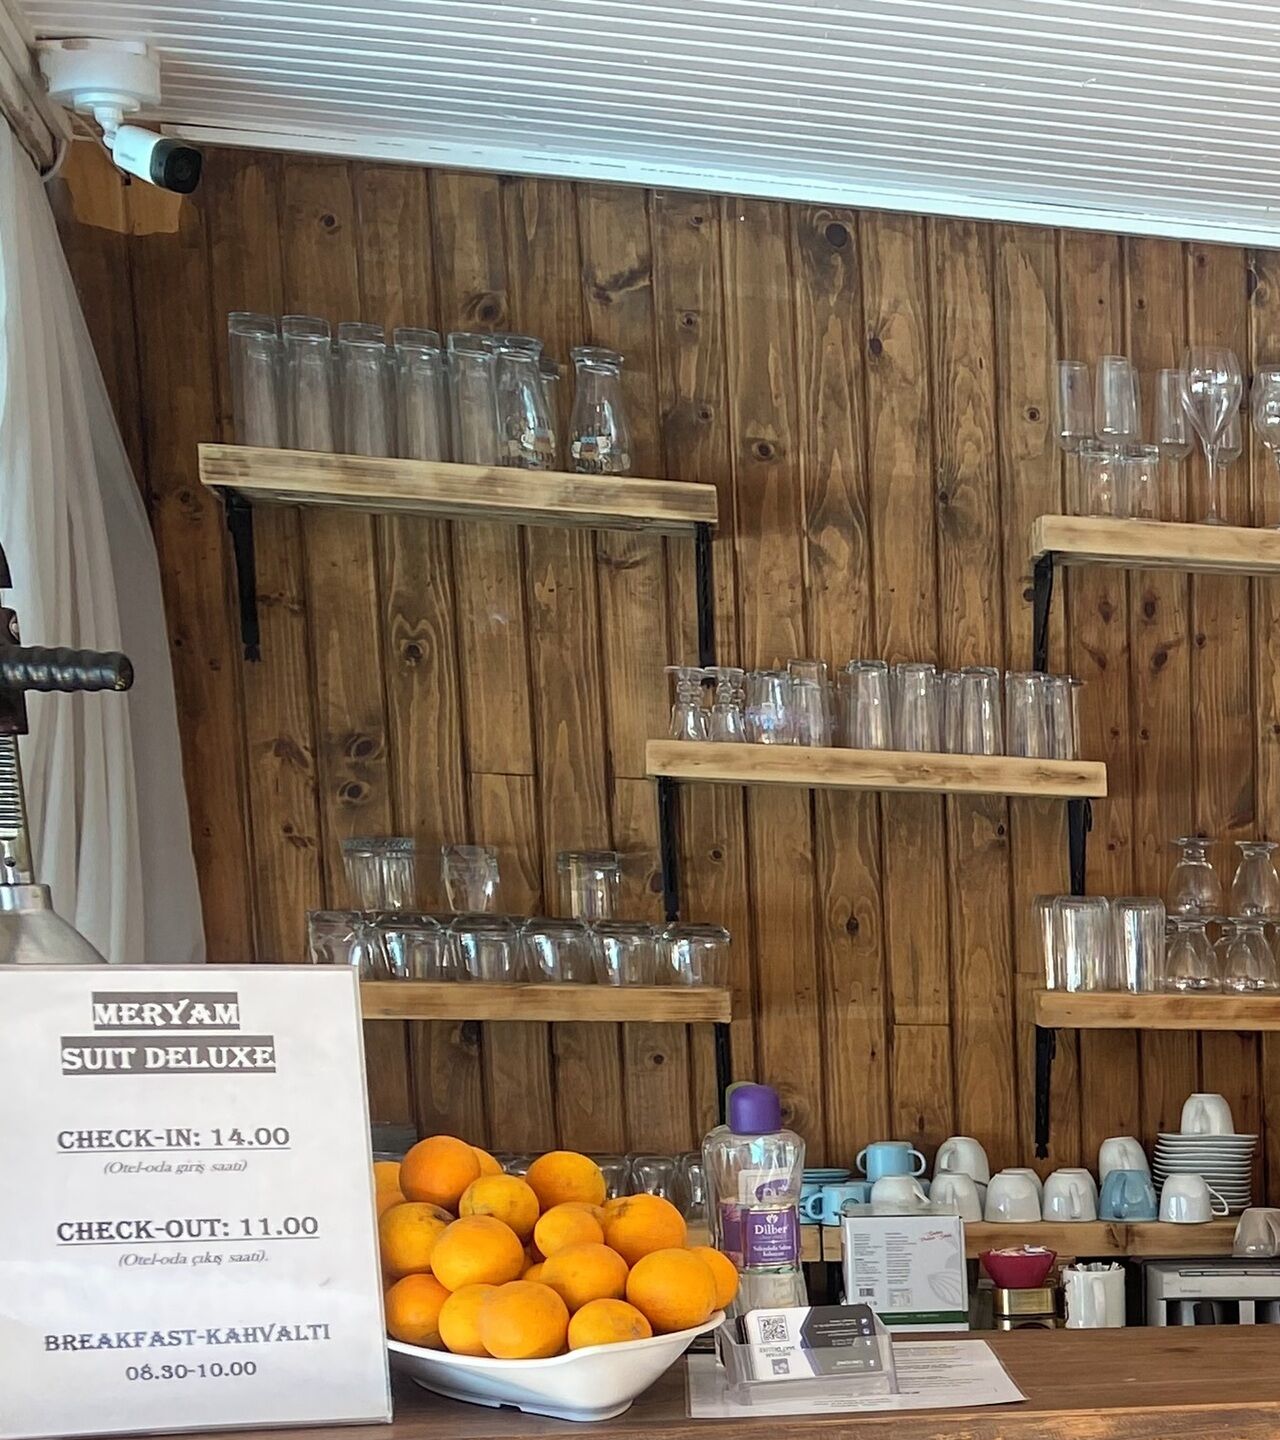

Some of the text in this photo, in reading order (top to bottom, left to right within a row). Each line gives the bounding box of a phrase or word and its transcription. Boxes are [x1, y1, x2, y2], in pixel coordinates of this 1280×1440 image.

[93, 998, 240, 1027] MERYAM
[62, 1045, 276, 1070] SUIT DELUXE
[57, 1126, 291, 1150] CHECK-IN: 14.00
[104, 1160, 172, 1175] (Otel-oda
[56, 1216, 320, 1242] CHECK-OUT: 11.00
[754, 1224, 789, 1236] Dilber
[118, 1252, 188, 1268] (Otel-oda
[44, 1322, 332, 1352] BREAKFAST-KAHVALTI
[125, 1360, 258, 1381] 08.30-10.00
